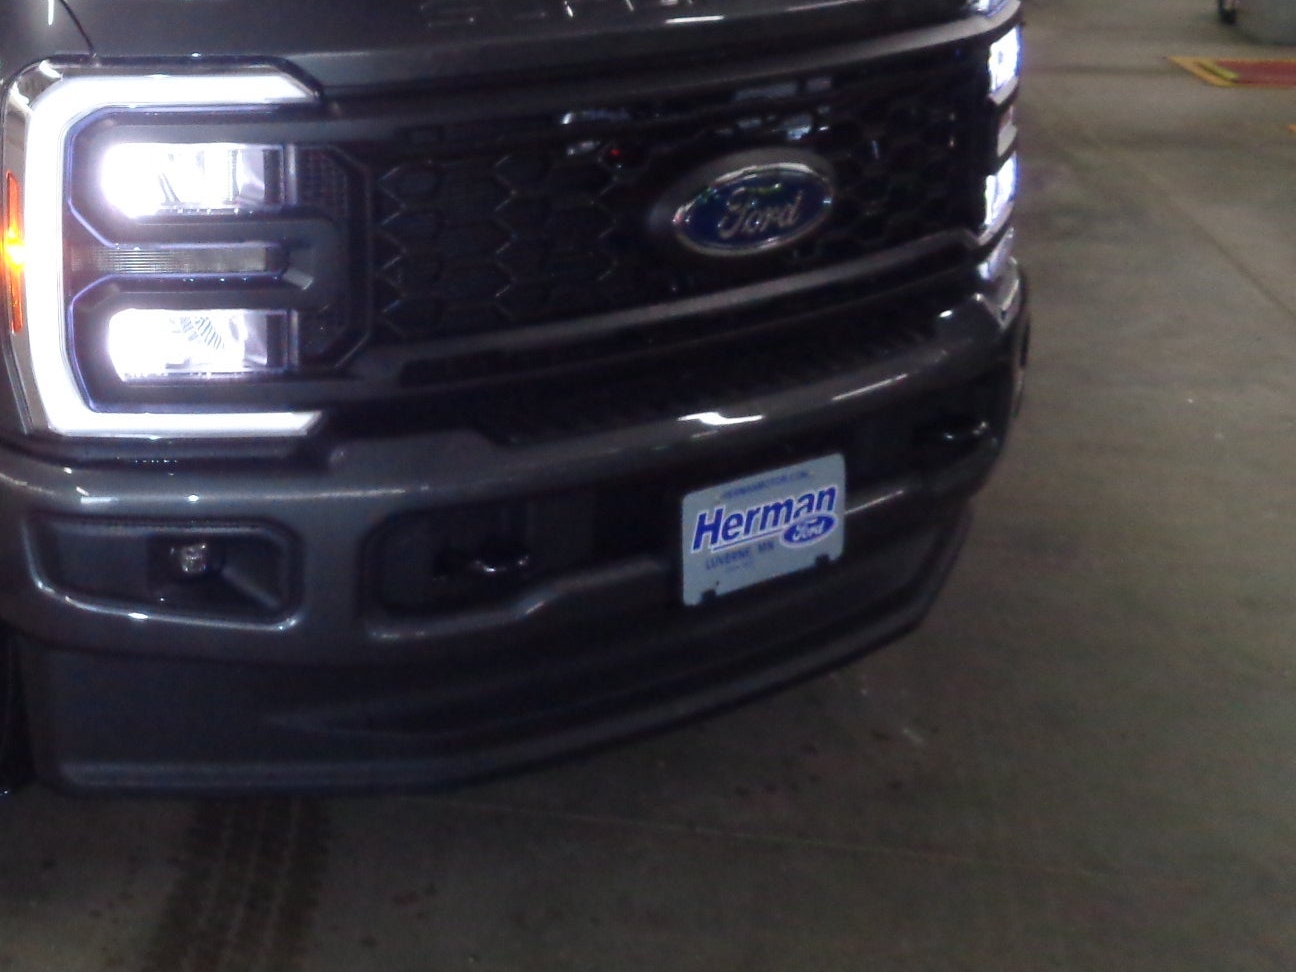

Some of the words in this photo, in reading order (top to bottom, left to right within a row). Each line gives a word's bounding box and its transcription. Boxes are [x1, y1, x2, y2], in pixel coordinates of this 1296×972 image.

[717, 183, 804, 239] Ford
[691, 485, 838, 551] Herman
[791, 518, 826, 541] Ford
